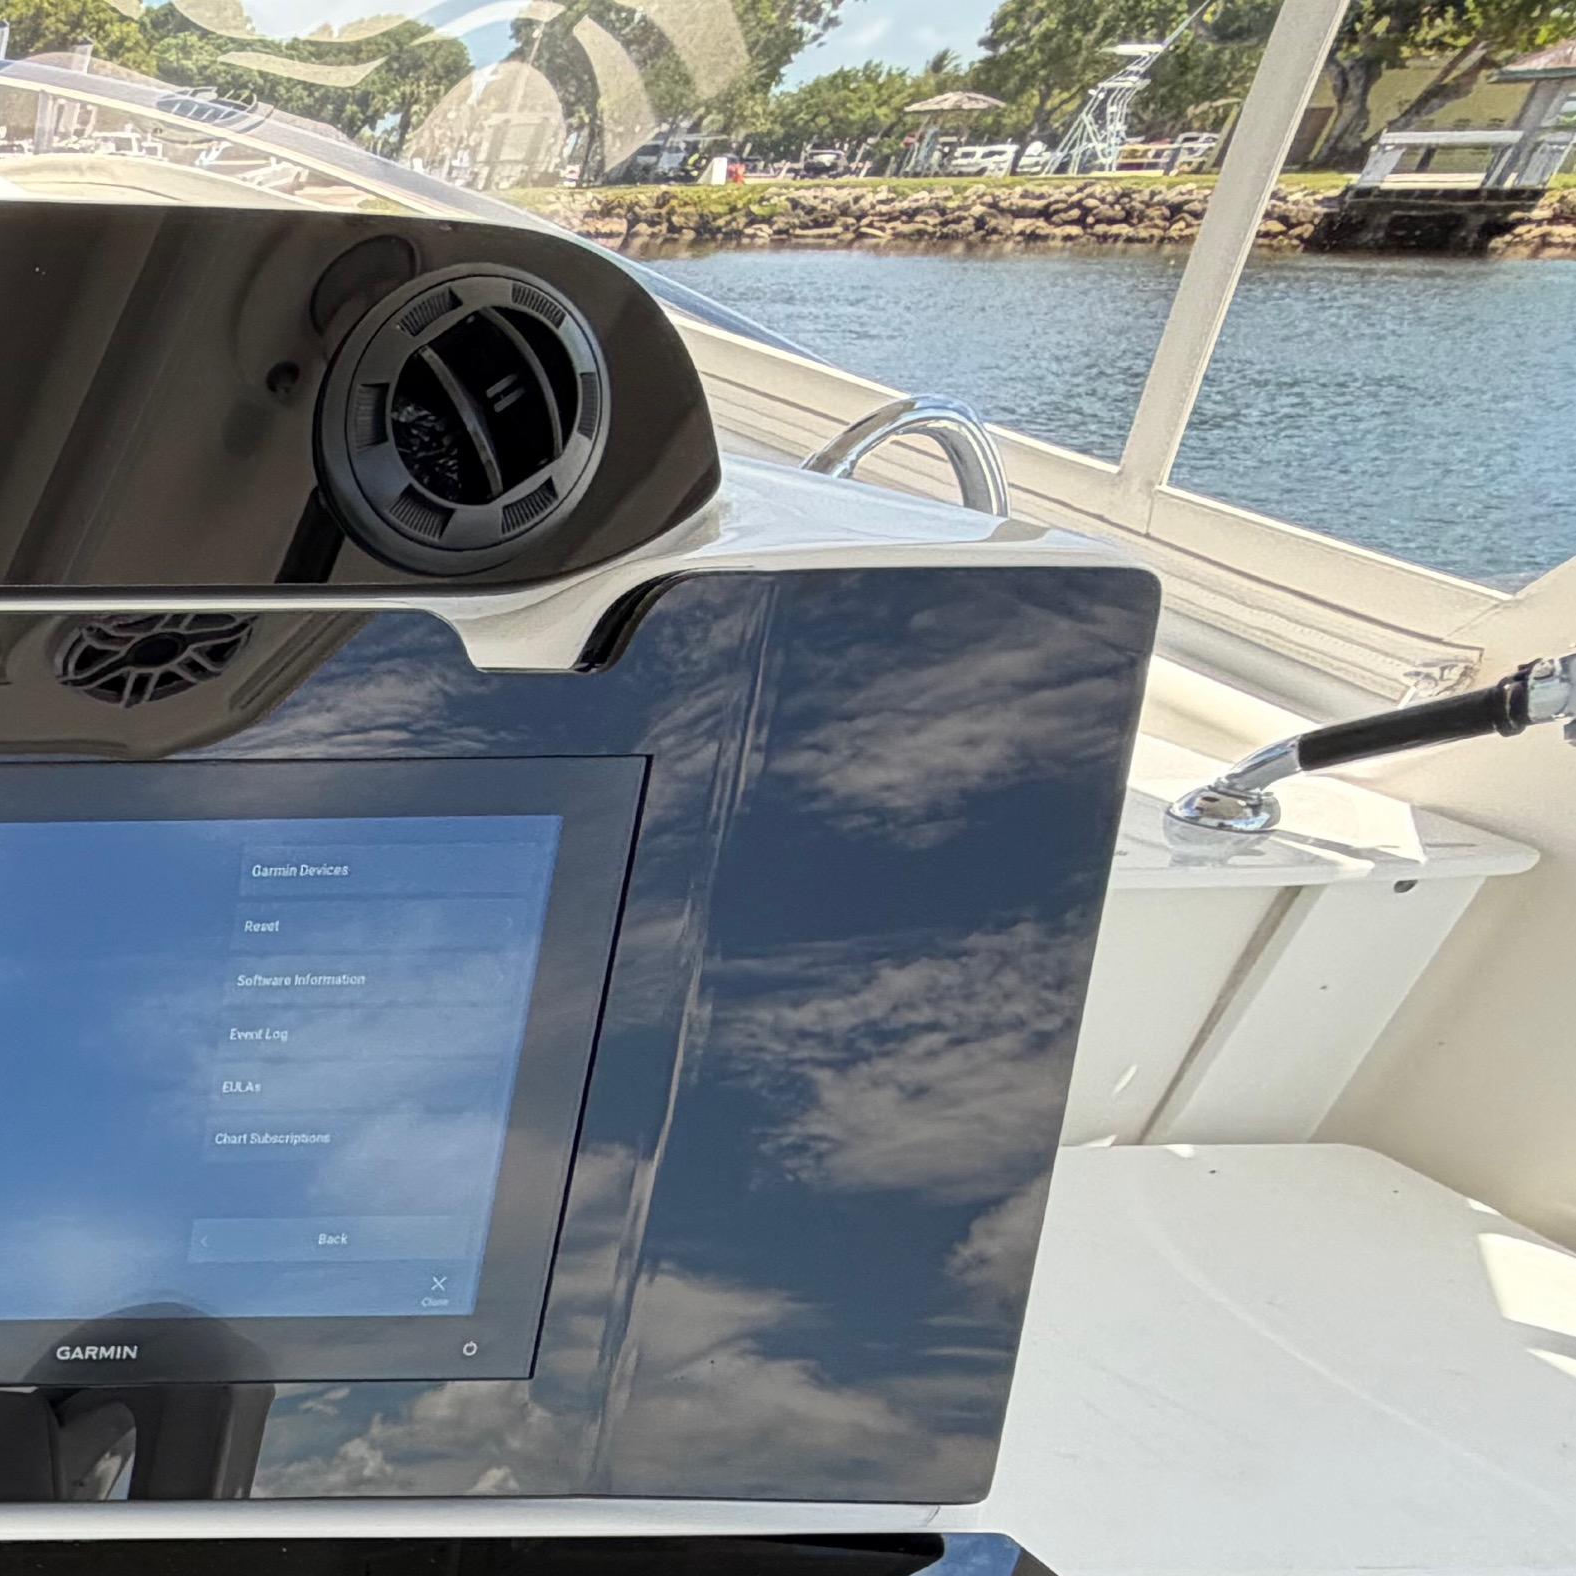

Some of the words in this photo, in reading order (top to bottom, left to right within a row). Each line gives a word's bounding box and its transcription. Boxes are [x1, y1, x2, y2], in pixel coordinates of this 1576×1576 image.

[252, 864, 297, 878] Garmin
[299, 863, 349, 877] Devices
[244, 920, 280, 933] Reset
[237, 974, 292, 987] Software
[294, 973, 367, 986] Information
[229, 1028, 262, 1041] Event
[265, 1028, 289, 1042] Log
[222, 1081, 262, 1093] EULAs
[215, 1132, 248, 1145] Chart
[249, 1132, 331, 1146] Subscriptions
[318, 1233, 348, 1245] Back
[56, 1346, 139, 1361] GARMIN
